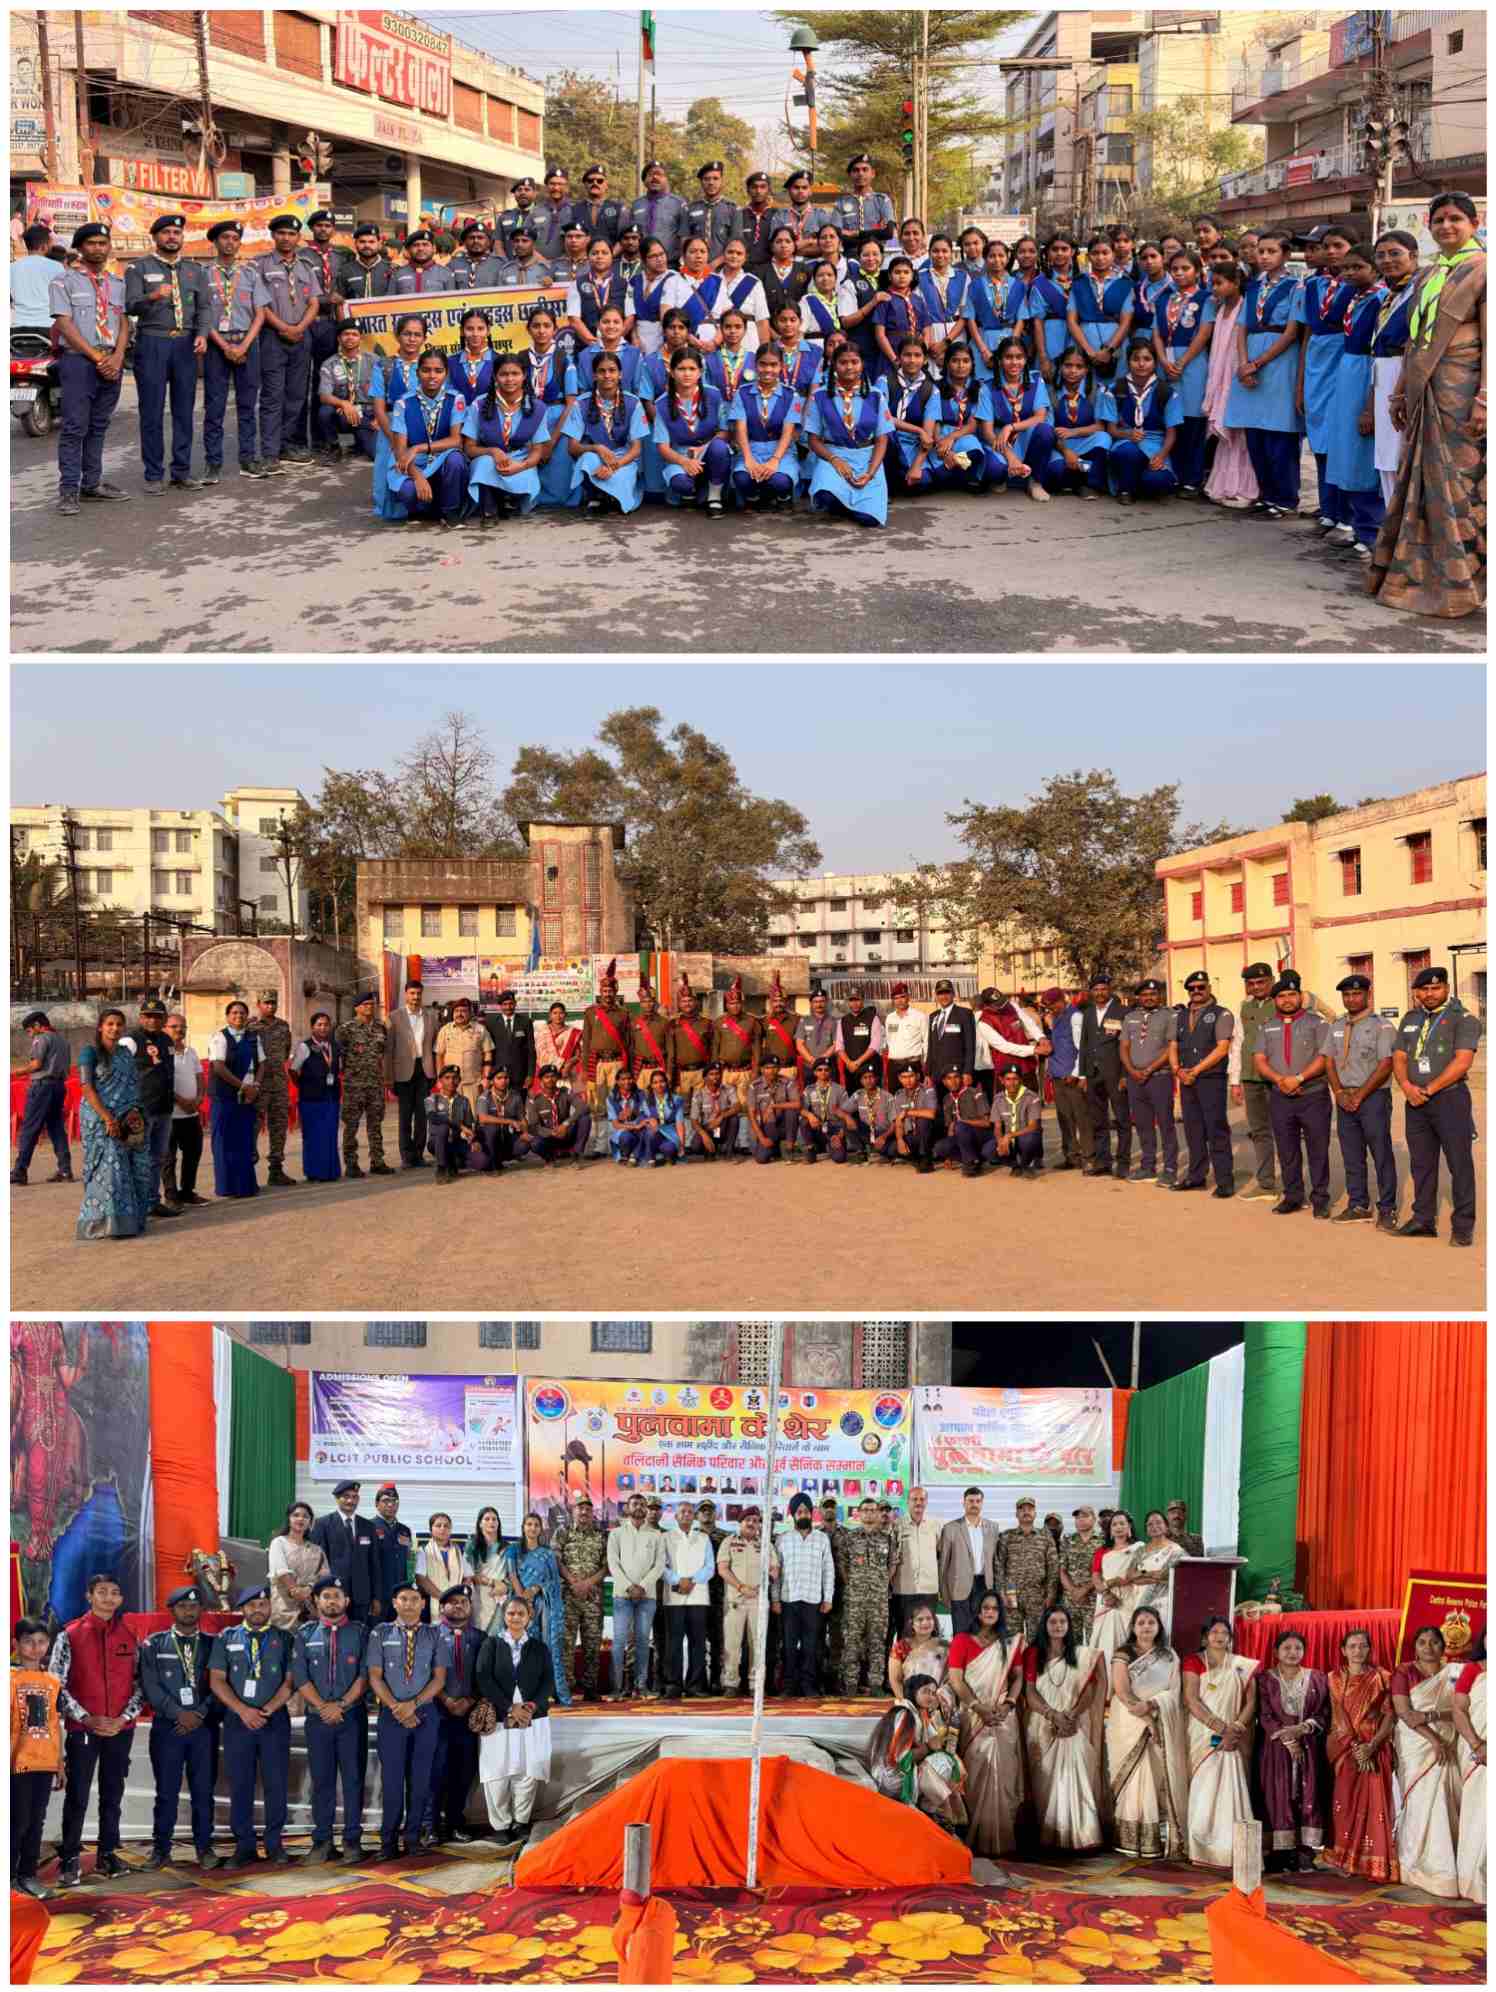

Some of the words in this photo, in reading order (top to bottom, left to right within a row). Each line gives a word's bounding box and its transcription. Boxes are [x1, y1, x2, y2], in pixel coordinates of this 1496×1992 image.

[139, 162, 189, 193] FILTER
[612, 1412, 735, 1443] पुलवामा
[783, 1411, 832, 1440] शेर
[329, 1452, 358, 1464] LCIT
[363, 1453, 412, 1465] PUBLIC
[415, 1454, 473, 1466] SCHOOL
[672, 1453, 706, 1468] सैनिक
[709, 1454, 745, 1471] परिवार
[790, 1456, 823, 1472] सैनिक
[825, 1460, 865, 1473] सम्मान
